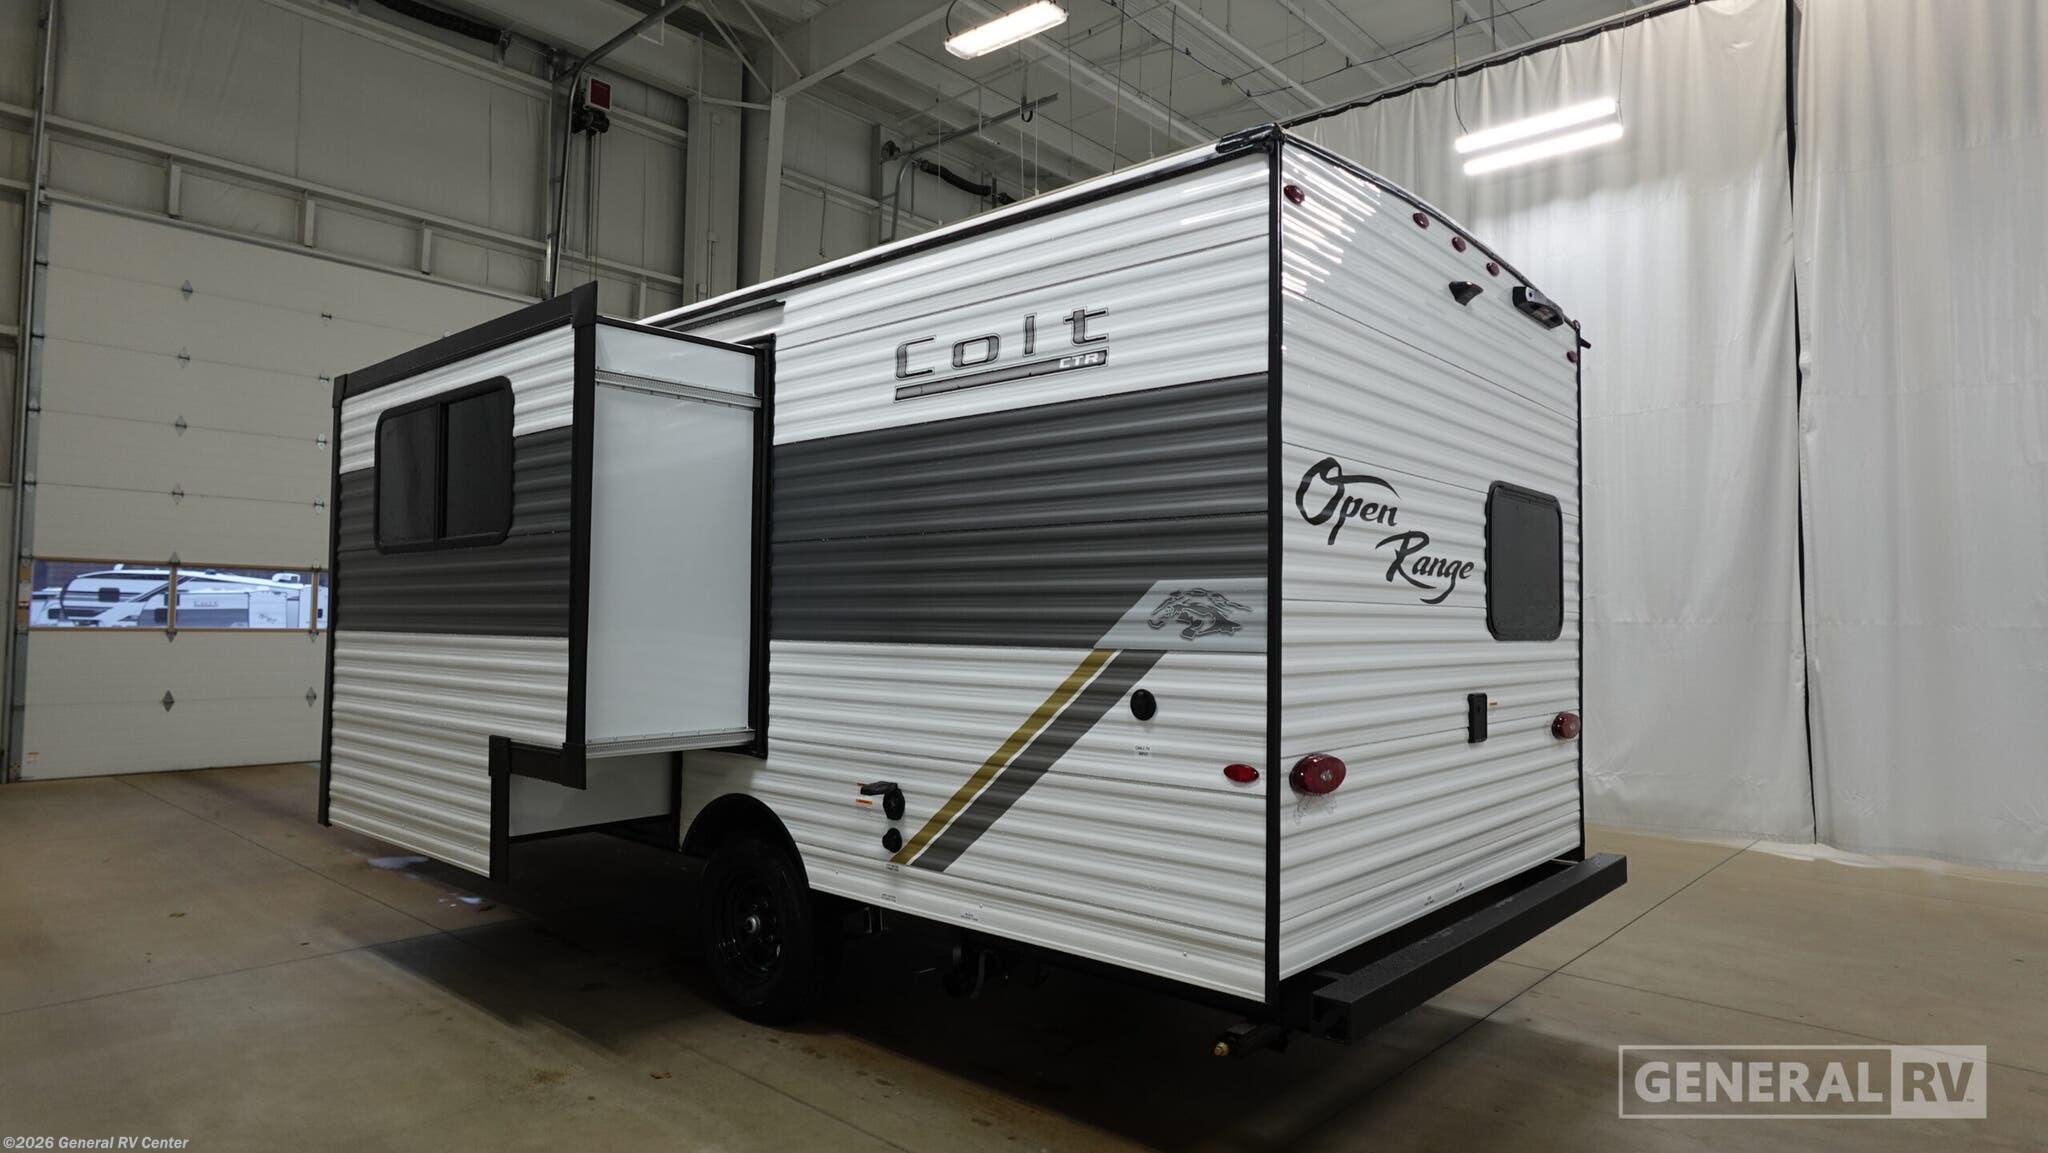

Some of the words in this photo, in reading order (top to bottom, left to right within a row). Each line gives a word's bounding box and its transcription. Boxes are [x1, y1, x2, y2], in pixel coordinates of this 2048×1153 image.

[895, 306, 1109, 380] Colt
[1058, 353, 1099, 369] CTR
[1295, 457, 1401, 545] Open
[1375, 531, 1475, 604] Range
